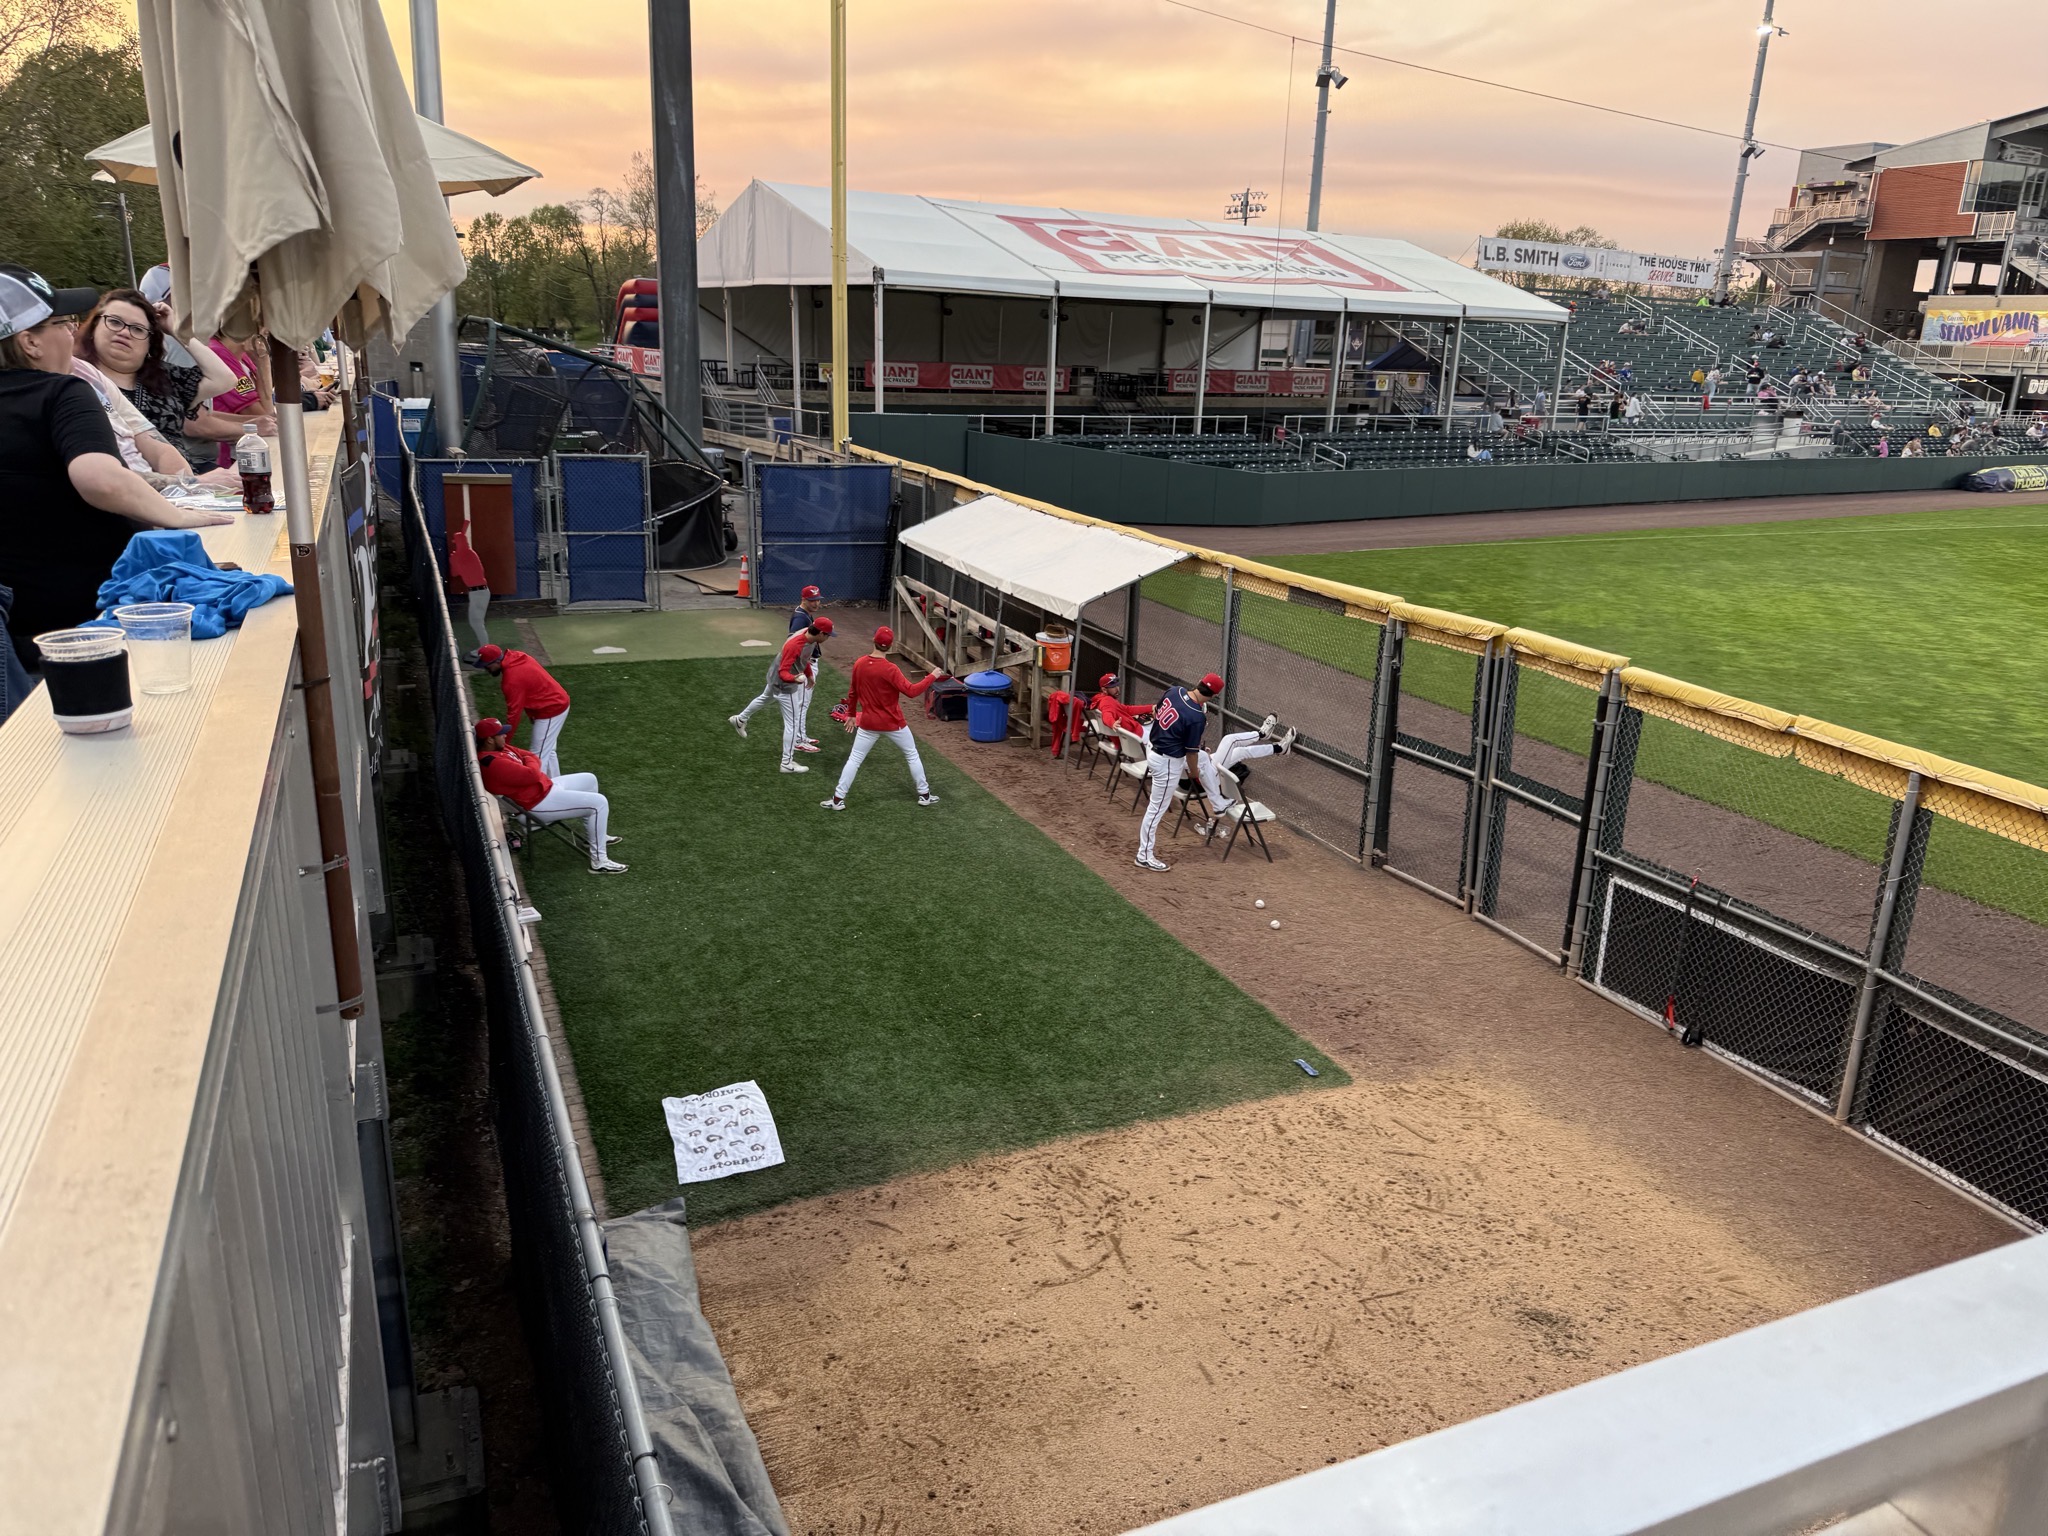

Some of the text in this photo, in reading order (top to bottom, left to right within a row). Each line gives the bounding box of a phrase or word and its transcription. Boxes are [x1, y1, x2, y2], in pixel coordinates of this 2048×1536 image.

[1057, 228, 1322, 267] GIANT
[1483, 245, 1559, 267] L.B. SMITH
[1567, 254, 1587, 268] Ford
[1639, 256, 1711, 273] THE HOUSE THAT
[1647, 269, 1699, 285] SERVICE BUILT
[1939, 311, 2040, 342] SENSYLVANIA
[951, 368, 993, 380] GIANT
[1024, 370, 1064, 382] GIAT
[1236, 375, 1268, 385] GIANT
[1293, 376, 1325, 385] GIANT
[2015, 467, 2043, 478] ON ALL
[2016, 477, 2046, 489] FLOORS
[1156, 697, 1179, 730] 30
